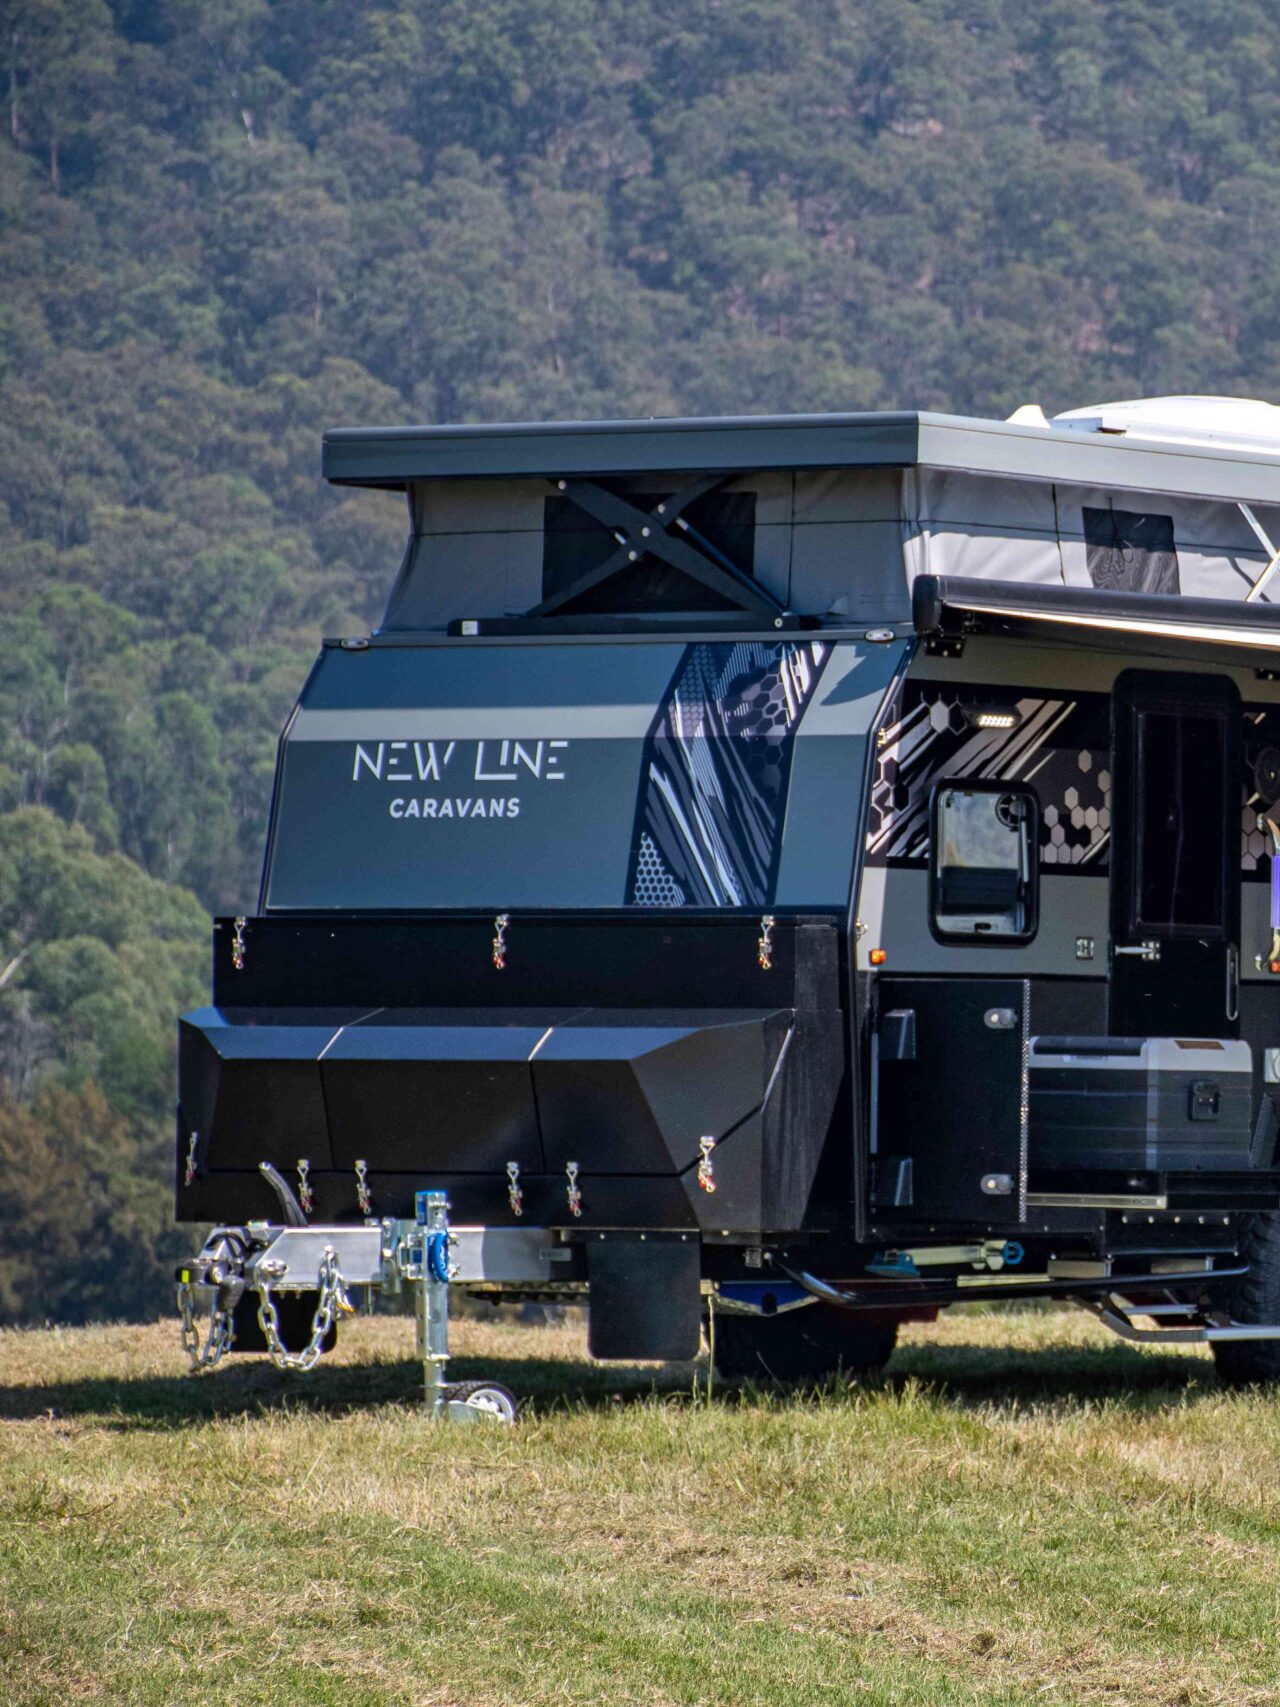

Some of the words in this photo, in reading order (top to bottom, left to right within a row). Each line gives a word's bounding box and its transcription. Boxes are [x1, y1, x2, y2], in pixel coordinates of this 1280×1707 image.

[352, 742, 456, 781] NEW
[474, 740, 569, 780] LINE
[388, 797, 520, 818] CARAVANS
